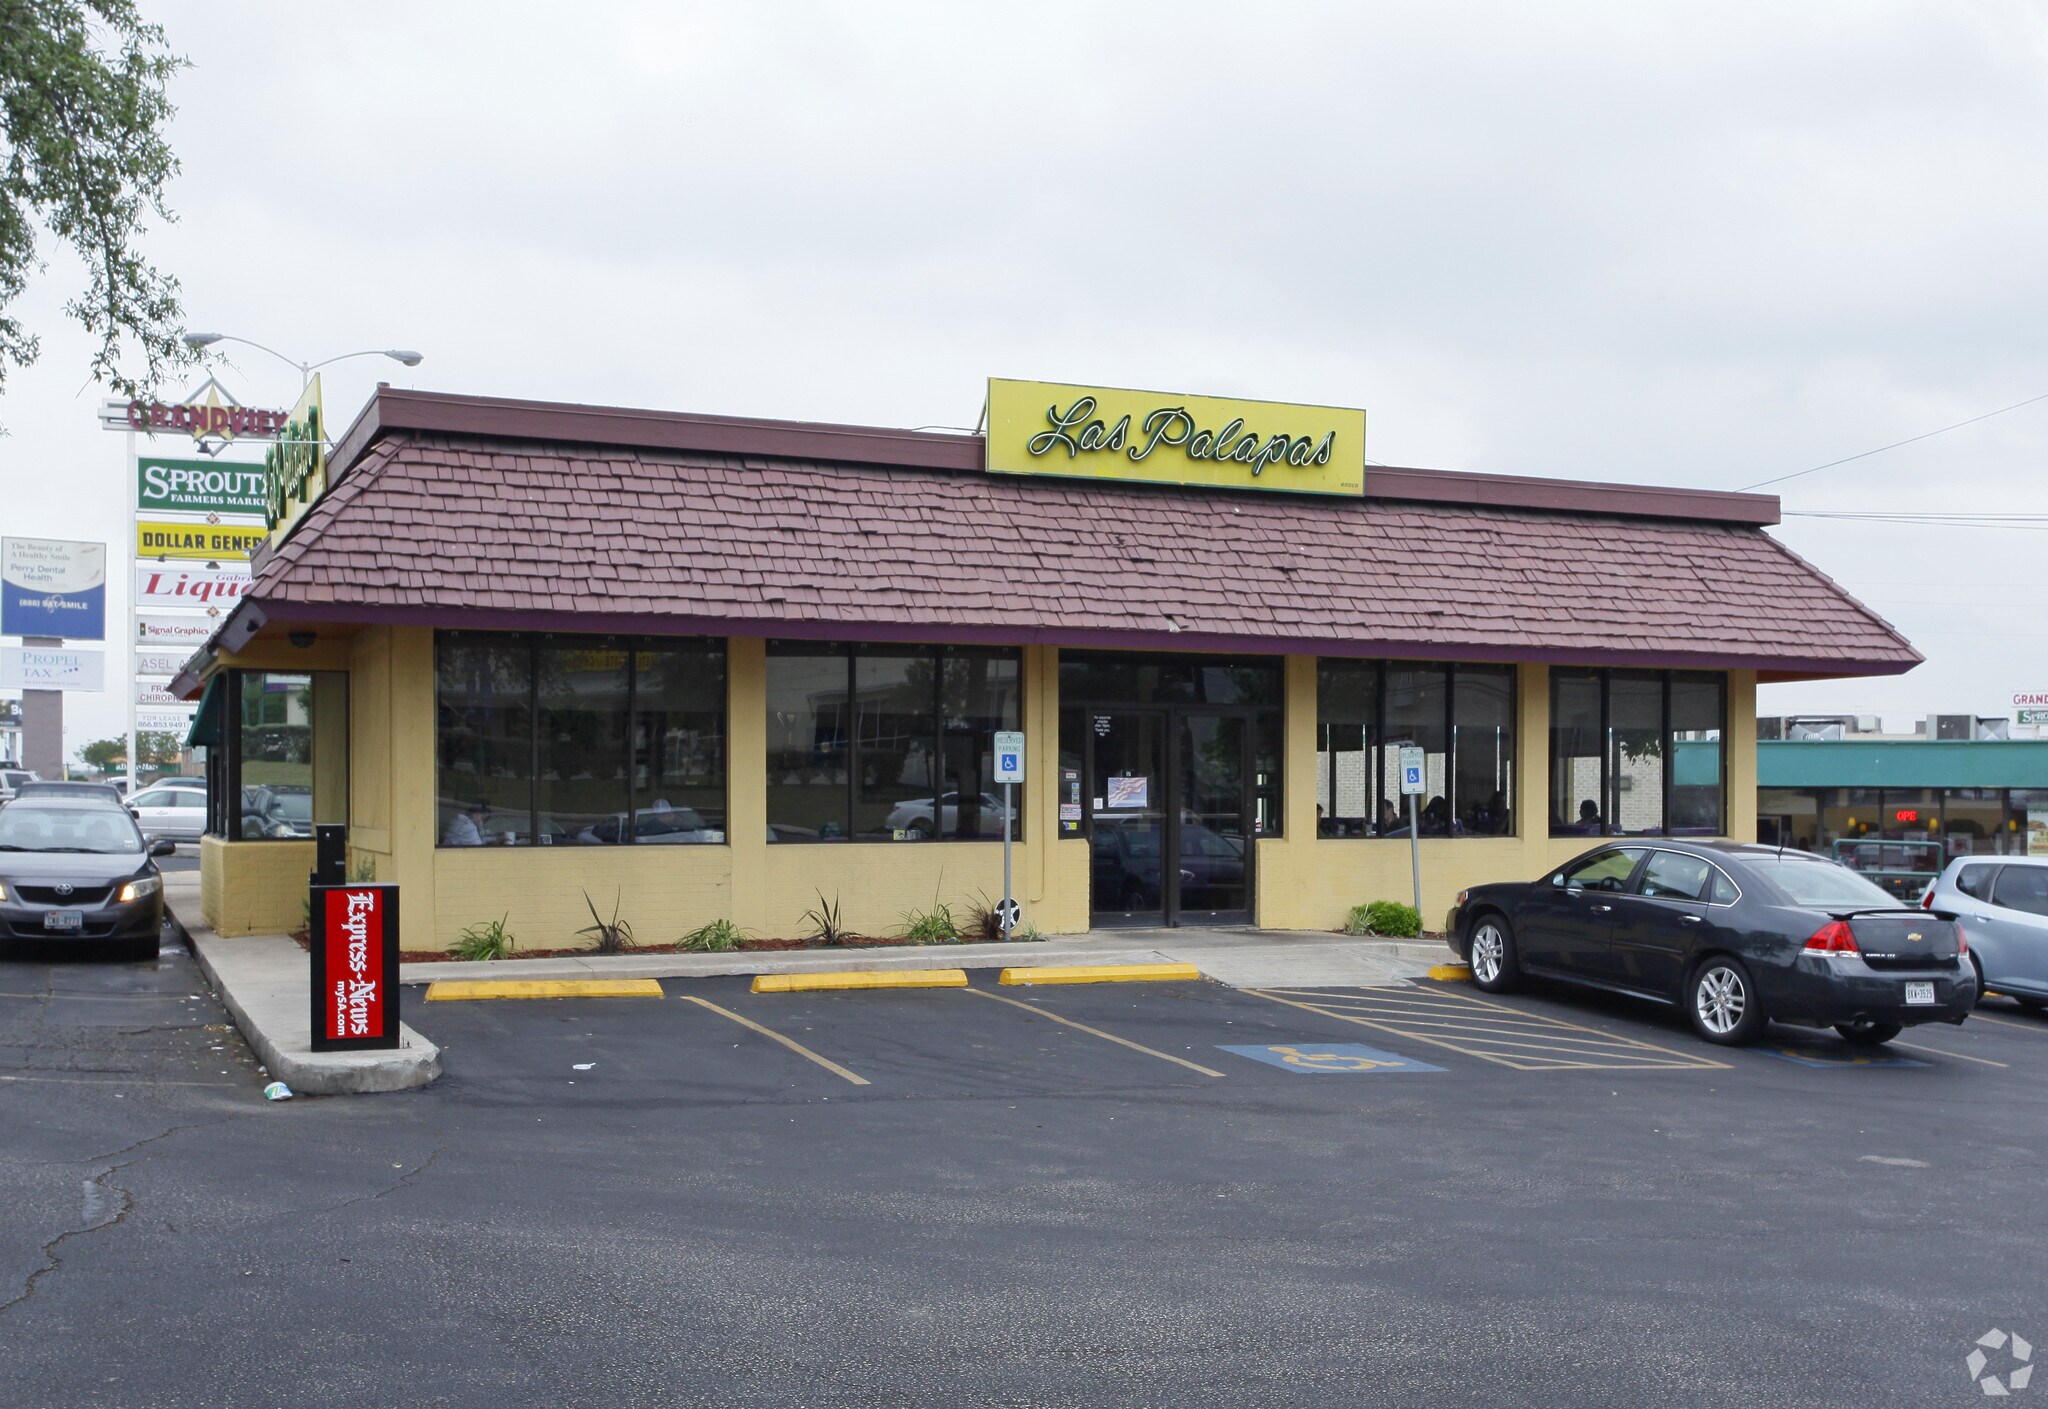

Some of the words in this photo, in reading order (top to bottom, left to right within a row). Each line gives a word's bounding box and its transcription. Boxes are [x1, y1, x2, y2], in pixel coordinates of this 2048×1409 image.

[1026, 395, 1131, 459] Las
[1127, 406, 1336, 477] Palapas
[170, 493, 224, 505] FARMERS
[143, 532, 206, 549] DOLLAR
[12, 542, 26, 550] The
[27, 543, 53, 552] Beauty
[19, 551, 48, 560] Healthy
[50, 552, 72, 561] Smile
[10, 563, 35, 574] Perry
[37, 564, 66, 574] Dental
[23, 572, 53, 582] Health
[147, 626, 173, 636] Signal
[174, 626, 209, 637] Graphics
[22, 651, 80, 666] PROPEL
[141, 658, 173, 670] ASEL
[22, 667, 52, 678] TAX
[341, 891, 377, 1036] Express-News
[335, 980, 347, 1037] mySA.com
